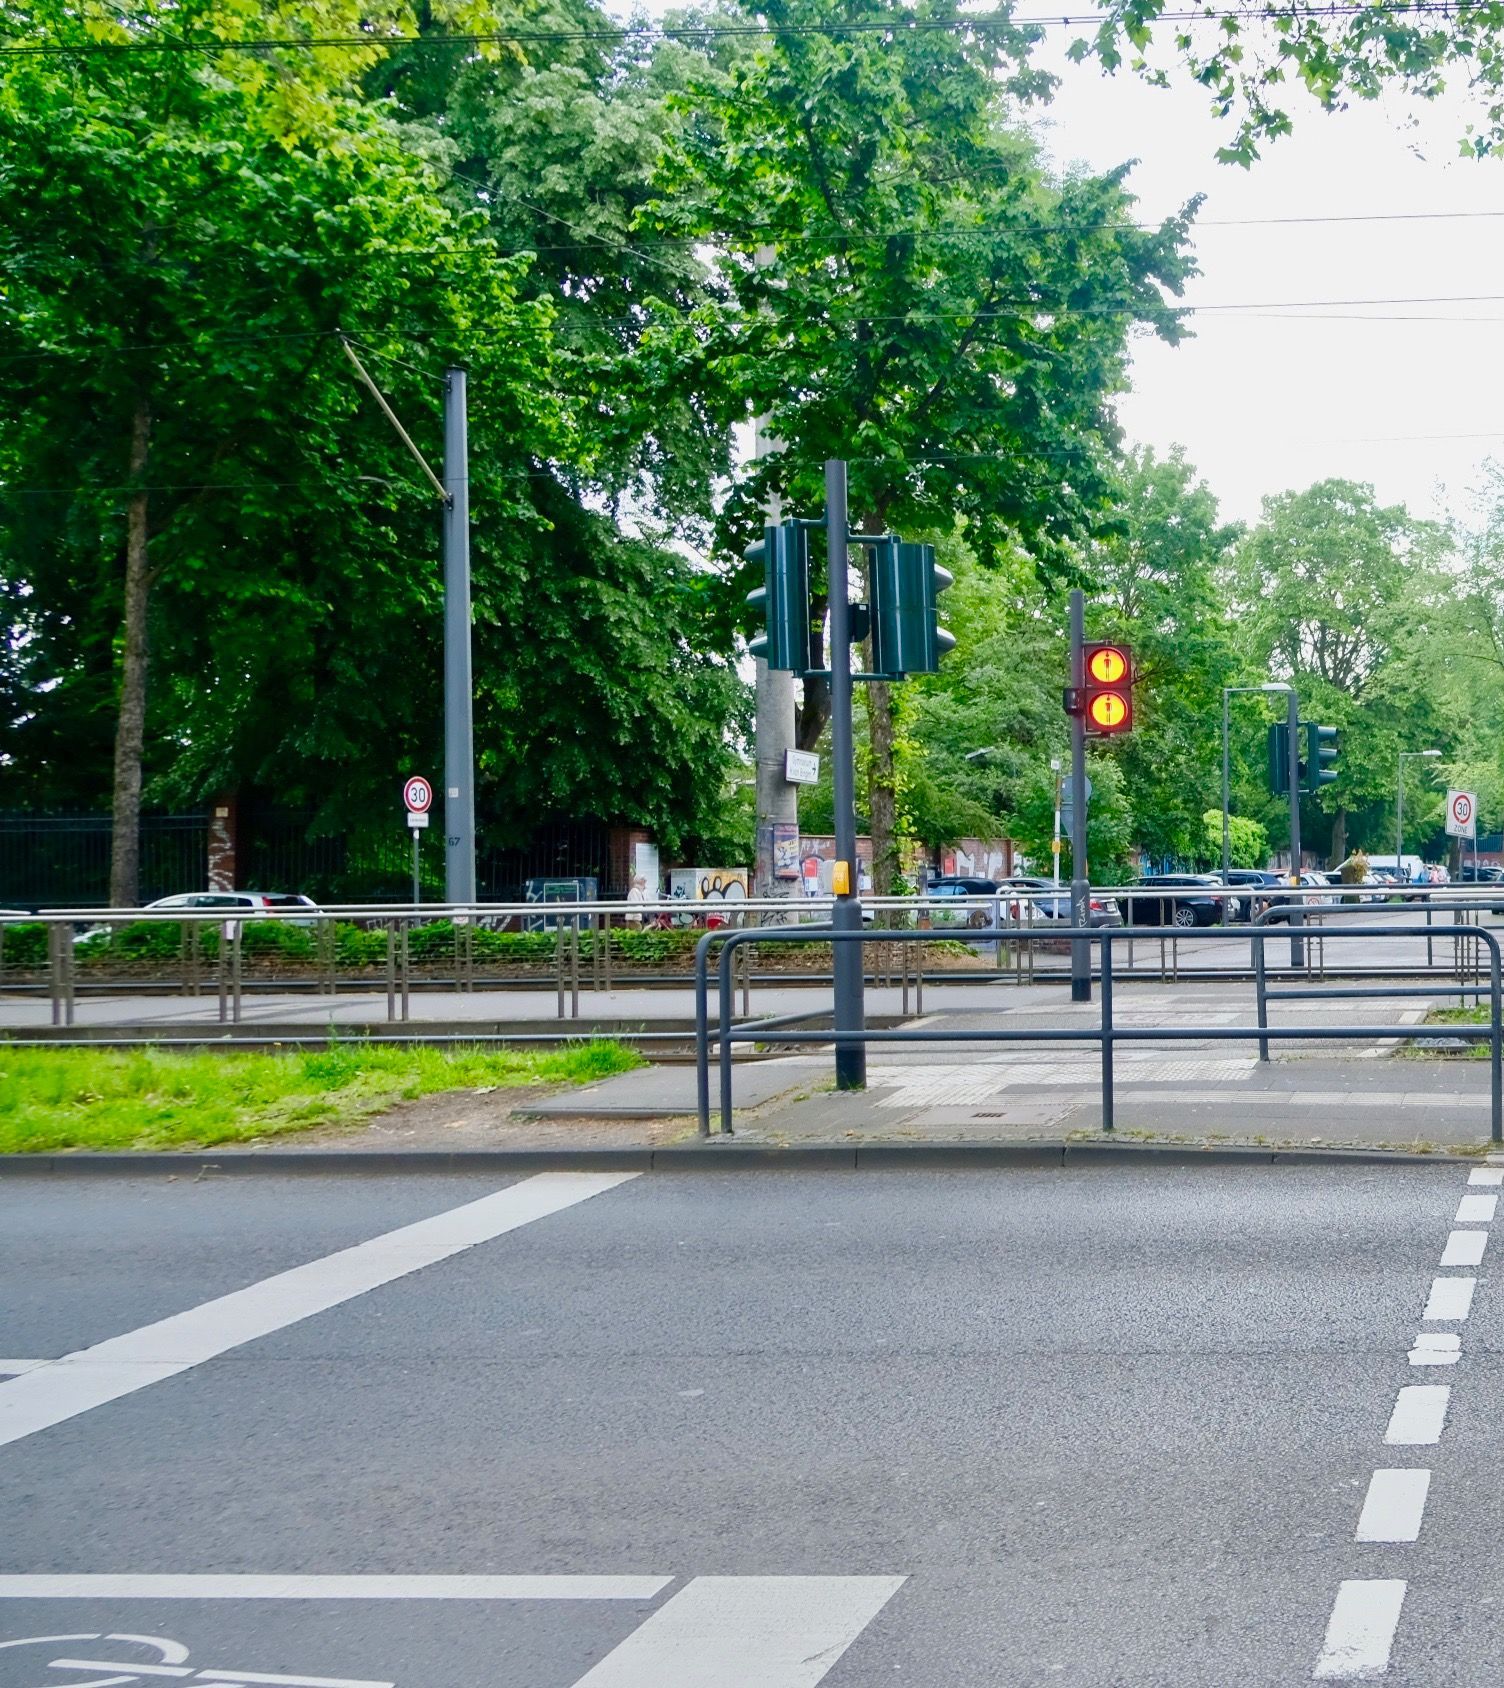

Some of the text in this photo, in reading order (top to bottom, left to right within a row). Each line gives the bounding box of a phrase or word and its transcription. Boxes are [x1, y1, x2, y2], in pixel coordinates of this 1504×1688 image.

[411, 788, 425, 802] 30
[1457, 802, 1468, 816] 30
[1454, 825, 1468, 834] ZONE
